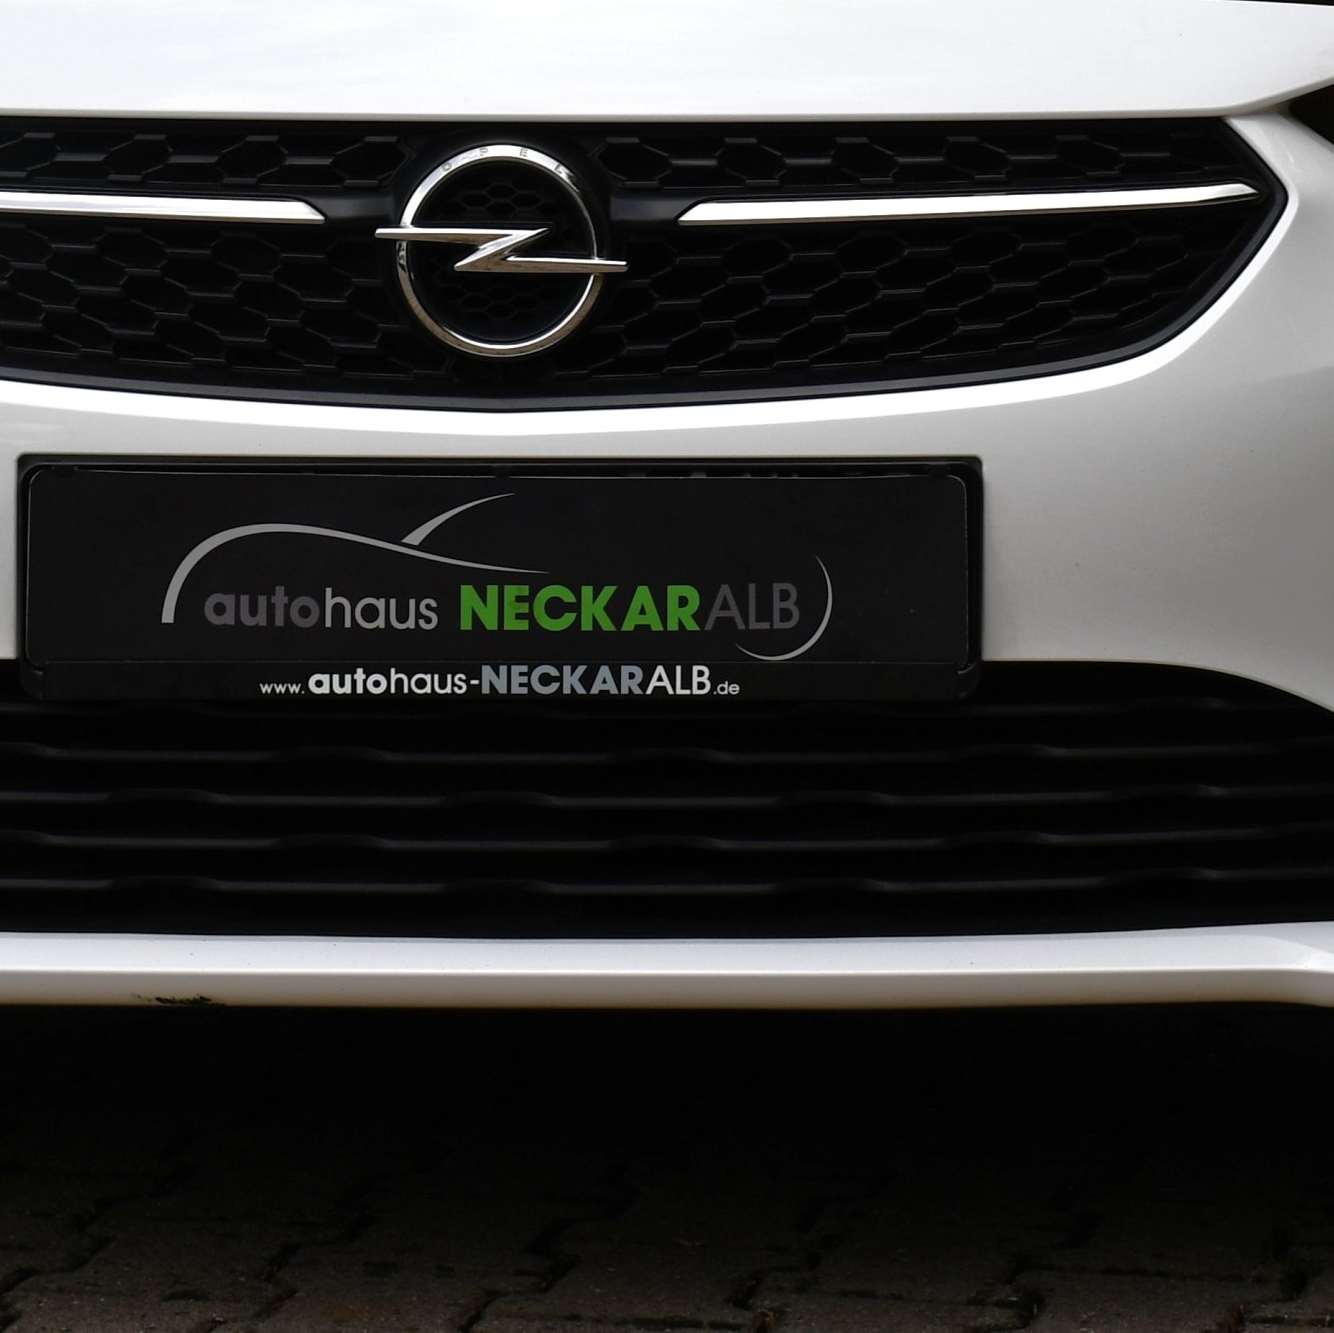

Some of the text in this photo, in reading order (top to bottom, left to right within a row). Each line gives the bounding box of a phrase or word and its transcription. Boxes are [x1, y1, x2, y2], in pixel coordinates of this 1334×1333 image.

[441, 147, 564, 174] OPEL
[203, 583, 801, 633] autohaus NECKARALB
